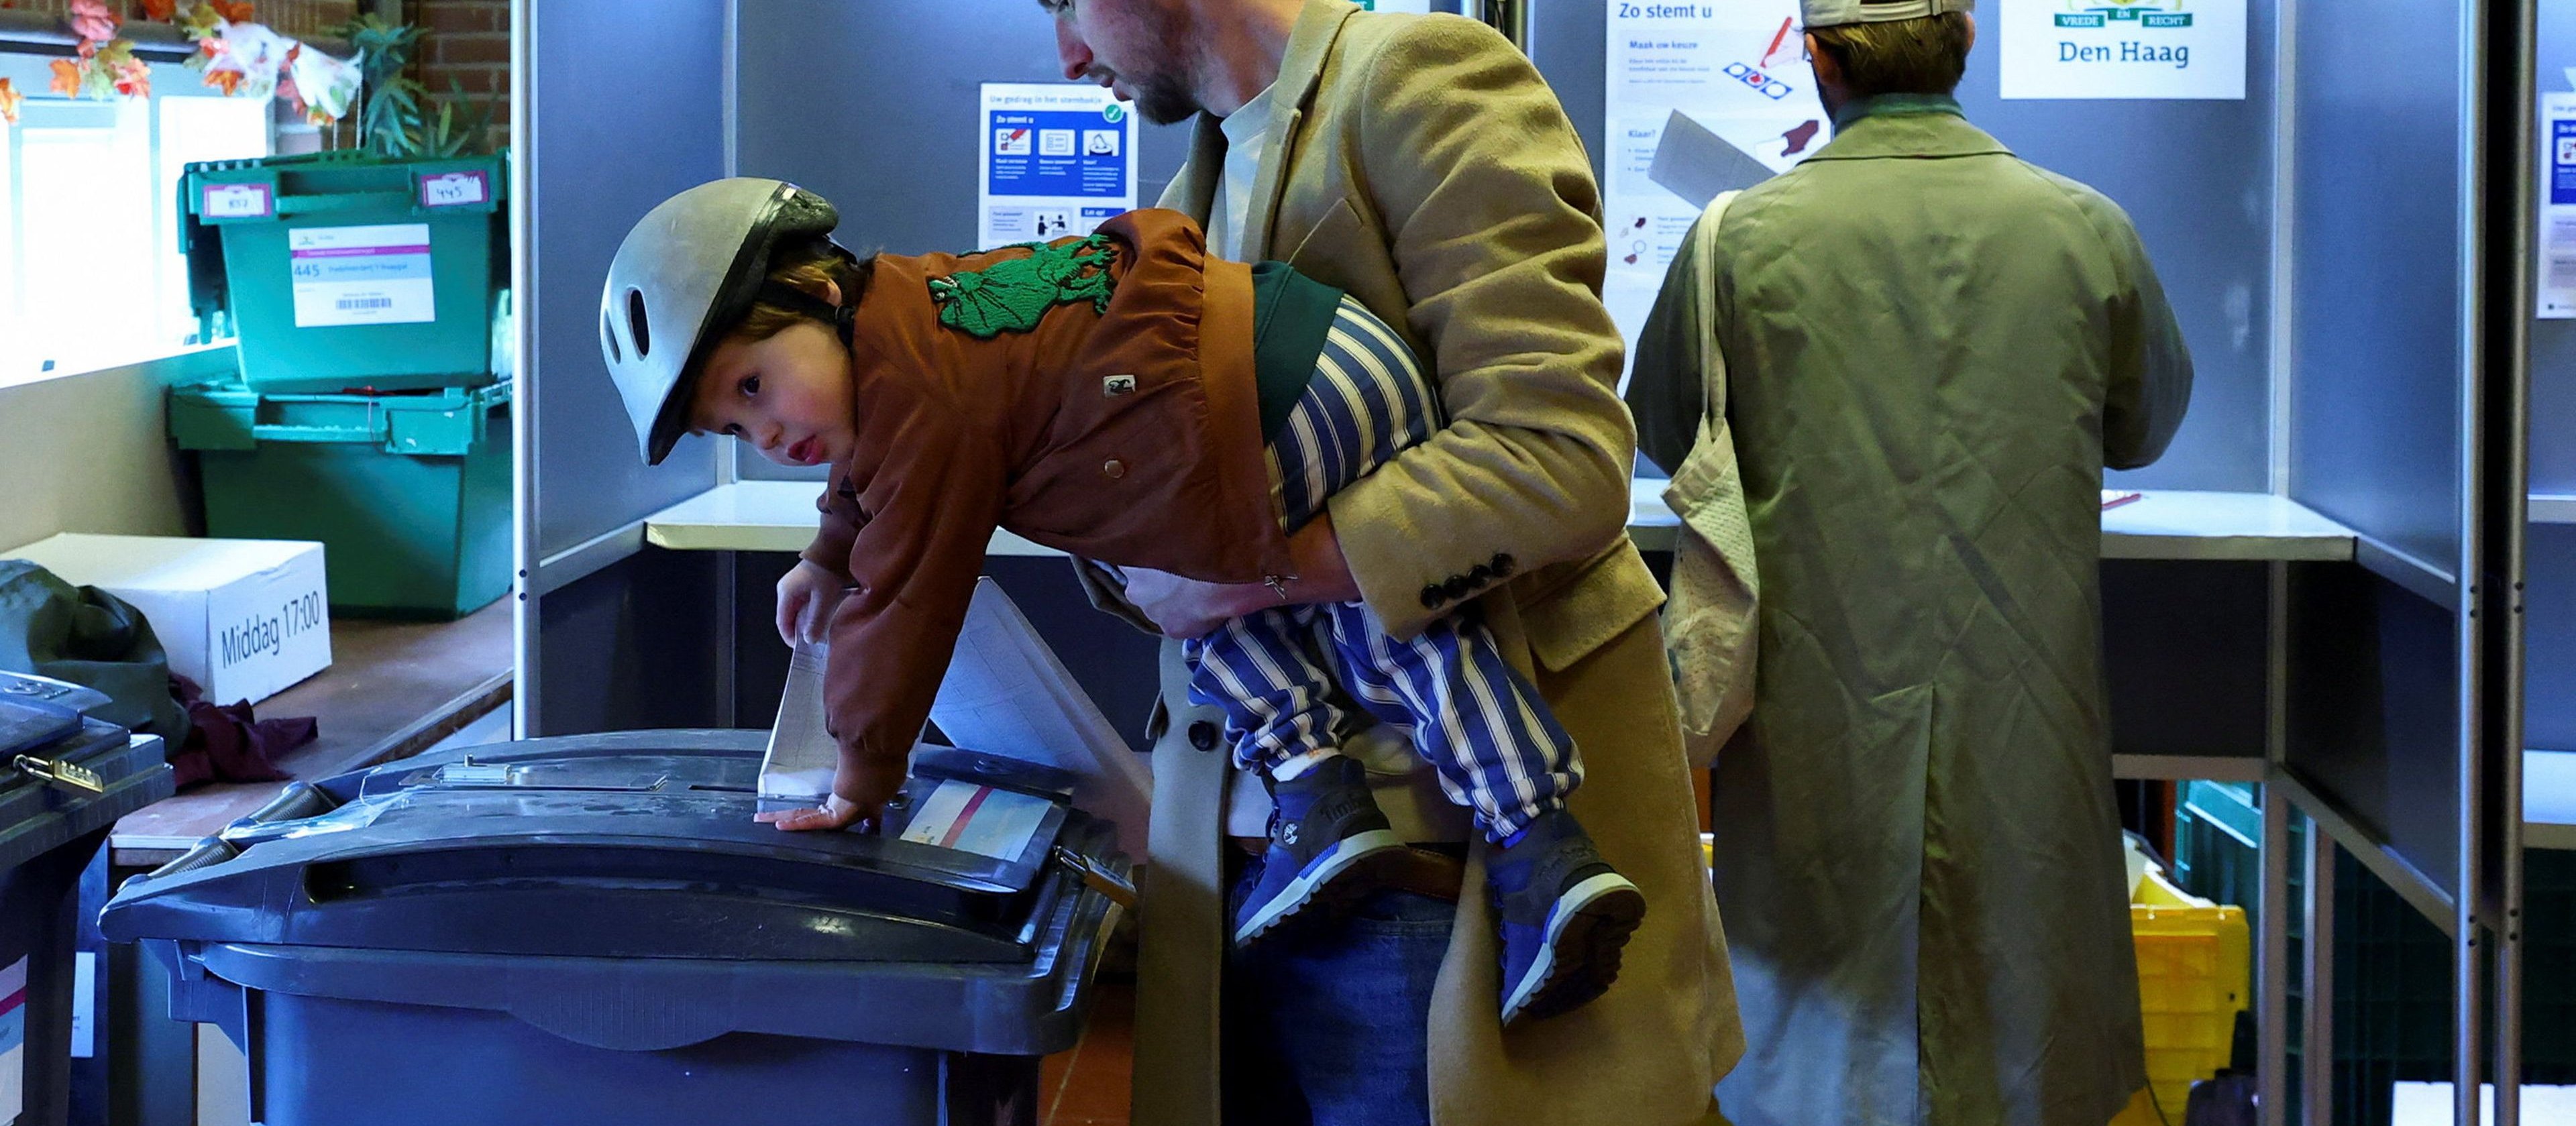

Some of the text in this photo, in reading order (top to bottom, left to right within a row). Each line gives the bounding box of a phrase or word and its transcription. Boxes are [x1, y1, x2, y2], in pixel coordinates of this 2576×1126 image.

[1619, 3, 1712, 18] Zo stemt u
[2061, 9, 2186, 26] VREDE EN RECHT
[1629, 40, 1654, 49] Maak
[1671, 40, 1698, 49] keuze
[2058, 41, 2190, 69] Den Haag
[1004, 95, 1032, 105] gedrag
[1628, 129, 1656, 137] Klaar?
[436, 186, 462, 199] 445
[294, 264, 320, 277] 445
[221, 590, 320, 669] Middag 17:00
